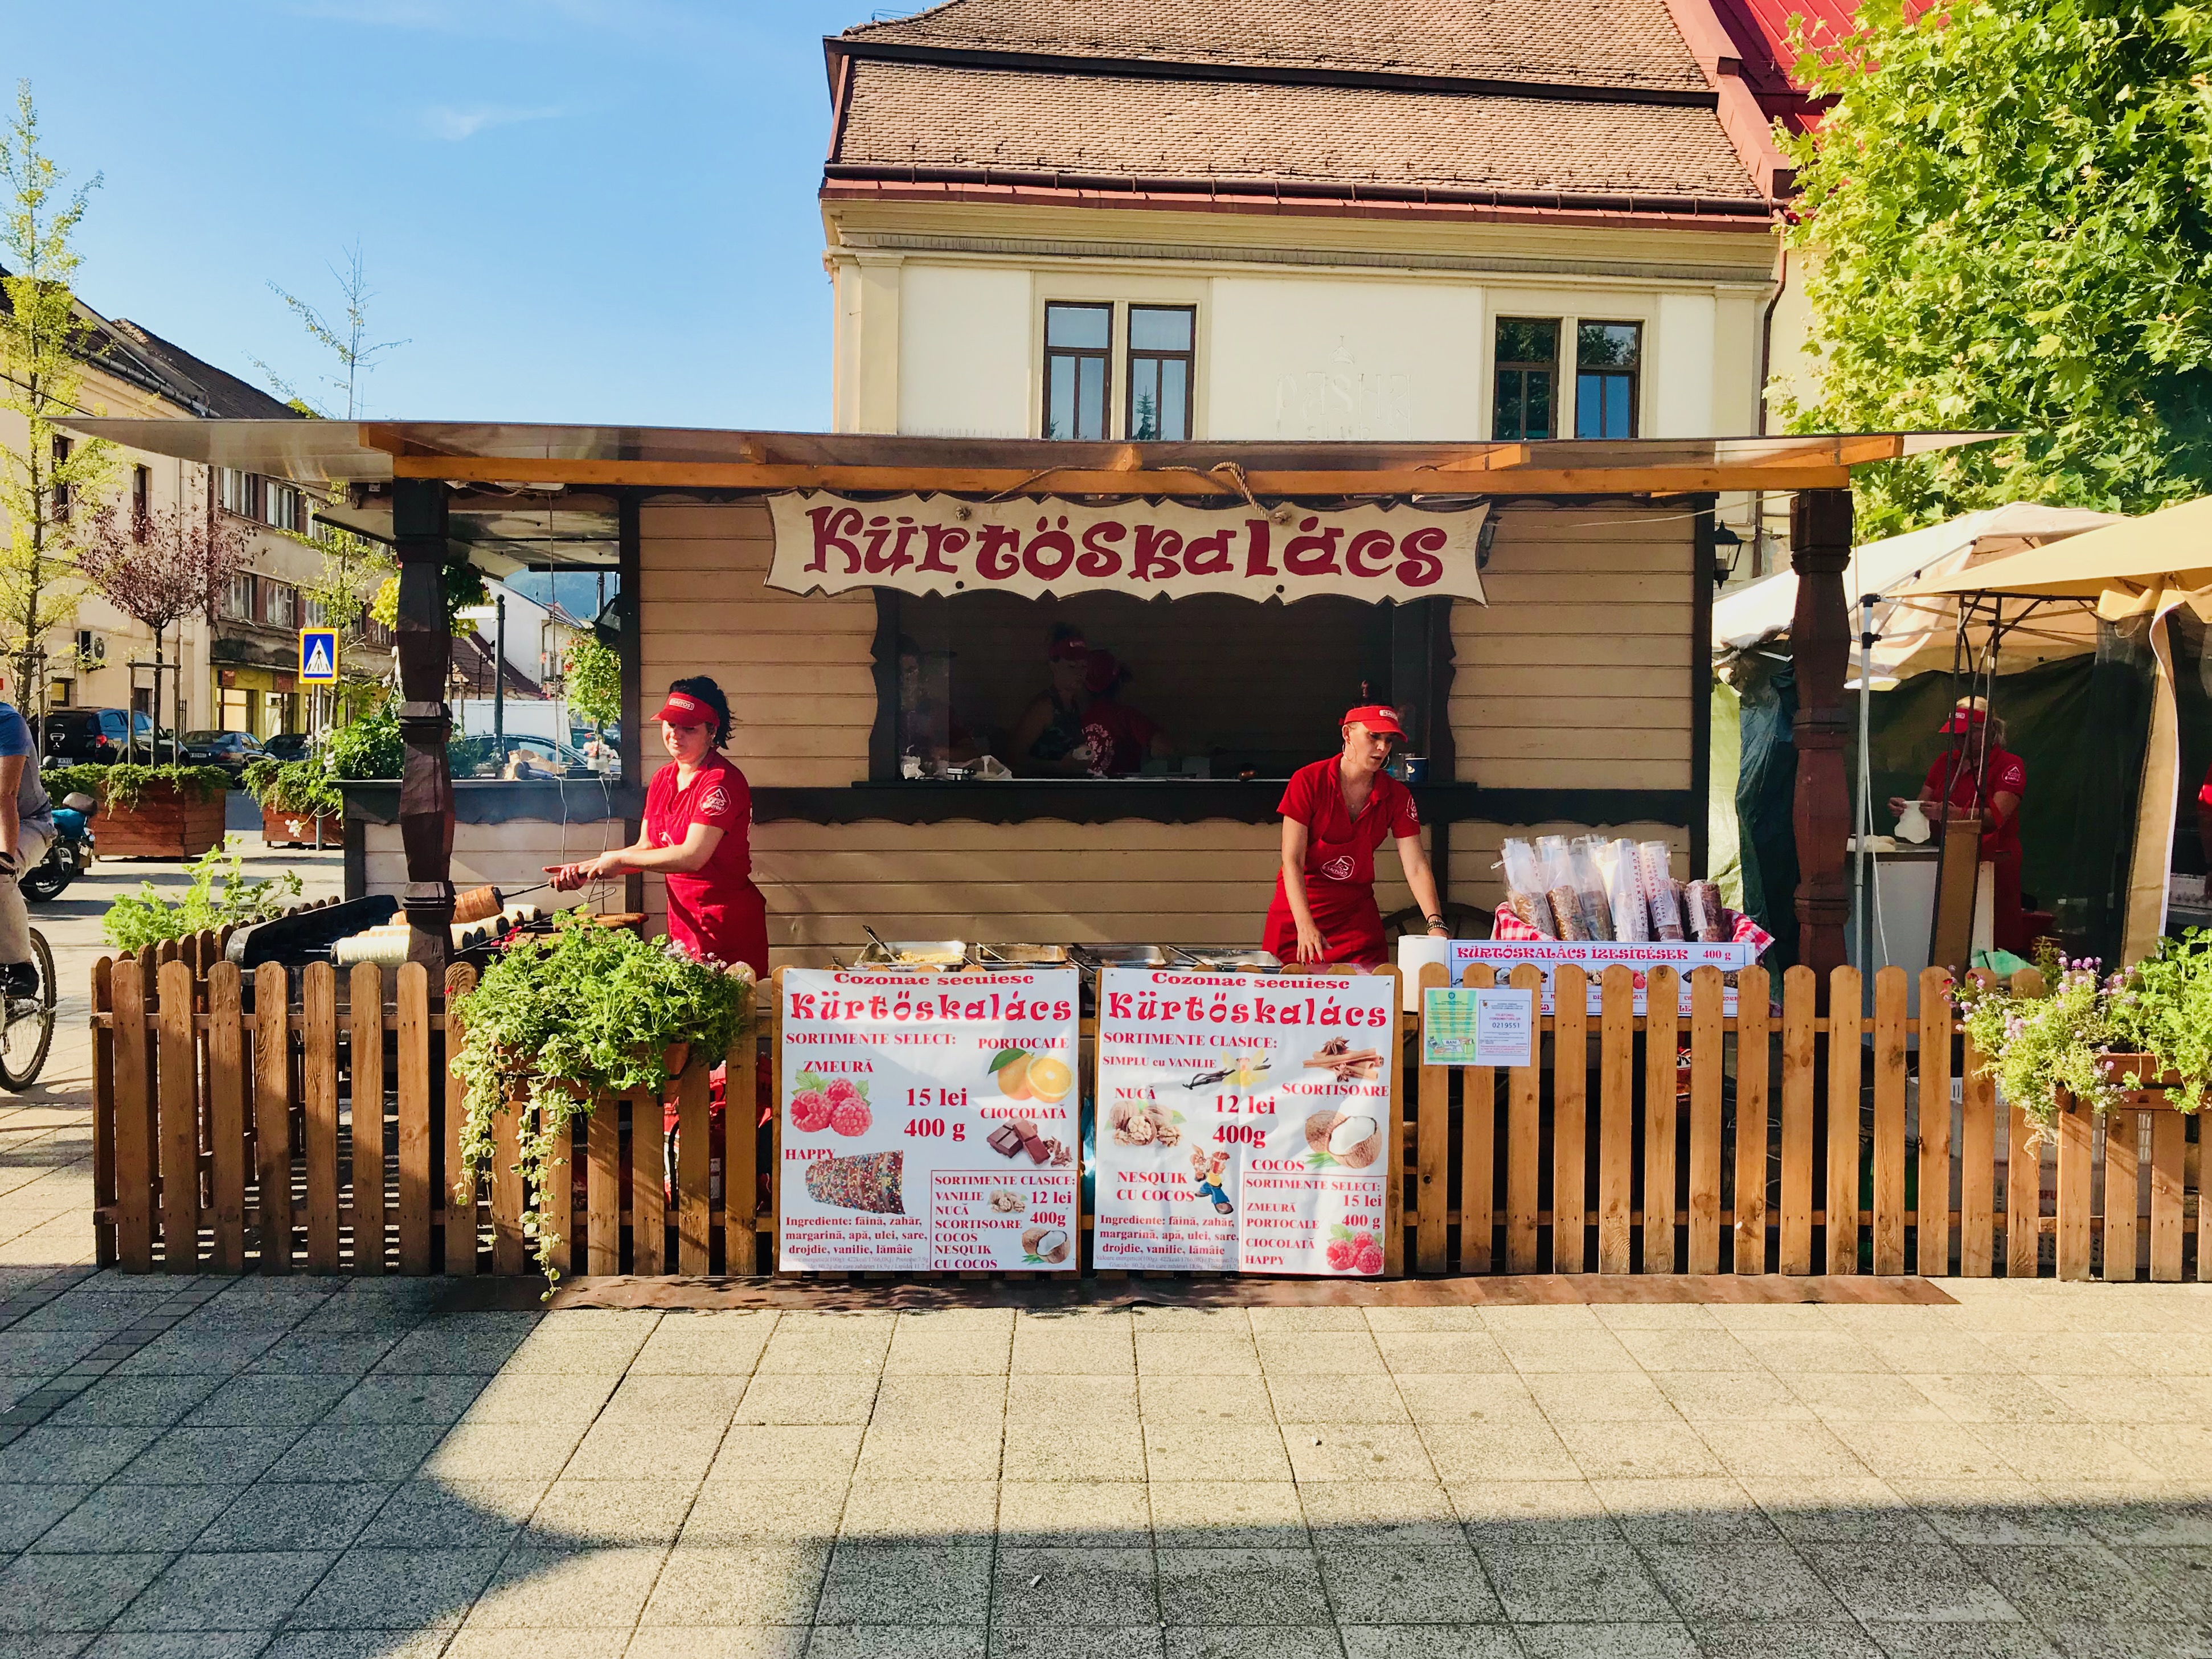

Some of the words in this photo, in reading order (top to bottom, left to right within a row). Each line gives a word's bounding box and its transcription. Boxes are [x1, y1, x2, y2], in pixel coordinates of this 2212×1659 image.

[1591, 945, 1688, 960] ÍZESÍTÉSEK
[1703, 950, 1722, 959] 400
[1724, 952, 1731, 961] g
[833, 972, 930, 986] Cozonac
[937, 973, 1035, 985] secuiesc
[1151, 972, 1247, 986] Cozonac
[1254, 977, 1350, 990] secuiesc
[790, 990, 1072, 1021] Kürtőskalács
[1108, 992, 1387, 1027] Kürtőskalács
[786, 1033, 889, 1044] SORTIMENTE
[894, 1033, 956, 1045] SELECT:
[978, 1038, 1069, 1049] PORTOCALE
[1103, 1032, 1205, 1046] SORTIMENTE
[1210, 1036, 1277, 1048] CLASICE:
[804, 1058, 874, 1073] ZMEURĂ
[1103, 1056, 1149, 1066] SIMPLU
[1169, 1059, 1216, 1068] VANILIE
[906, 1088, 931, 1107] 15
[940, 1087, 968, 1107] lei
[1115, 1086, 1156, 1099] NUCĂ
[1215, 1095, 1239, 1113] 12
[1247, 1096, 1276, 1114] lei
[980, 1104, 1067, 1119] CIOCOLATĂ
[904, 1119, 945, 1137] 400
[952, 1123, 965, 1141] g
[1212, 1125, 1267, 1148] 400g
[785, 1149, 835, 1160] HAPPY
[1252, 1160, 1305, 1171] COCOS
[935, 1176, 1017, 1185] SORTIMENTE
[1021, 1176, 1075, 1185] CLASICE:
[1117, 1171, 1187, 1185] NESQUIK
[1246, 1179, 1327, 1190] SORTIMENTE
[1332, 1182, 1381, 1191] SELECT:
[935, 1191, 984, 1201] VANILIE
[1031, 1191, 1048, 1204] 12
[1053, 1191, 1072, 1204] lei
[1117, 1190, 1138, 1201] CU
[1142, 1190, 1195, 1202] COCOS
[1343, 1195, 1360, 1207] 15
[1365, 1194, 1382, 1207] lei
[935, 1203, 969, 1215] NUCĂ
[1247, 1202, 1296, 1212] ZMEURĂ
[786, 1216, 852, 1228] Ingrediente:
[855, 1216, 886, 1227] făină,
[889, 1217, 922, 1227] zahăr,
[1030, 1211, 1066, 1227] 400g
[1100, 1215, 1165, 1227] Ingrediente:
[1168, 1215, 1199, 1227] făină,
[1202, 1216, 1235, 1228] zahăr,
[1246, 1218, 1319, 1229] PORTOCALE
[1342, 1215, 1368, 1226] 400
[1373, 1218, 1381, 1229] g
[849, 1231, 871, 1243] apă,
[875, 1230, 898, 1242] ulei,
[902, 1232, 927, 1242] sare,
[935, 1232, 978, 1242] COCOS
[1162, 1230, 1184, 1242] apă,
[1188, 1230, 1211, 1242] ulei,
[1215, 1232, 1239, 1243] sare,
[1246, 1237, 1315, 1249] CIOCOLATĂ
[788, 1245, 830, 1256] drojdie,
[833, 1245, 872, 1256] vanilie,
[935, 1245, 992, 1256] NESQUIK
[1102, 1243, 1144, 1256] drojdie,
[1146, 1244, 1186, 1256] vanilie,
[935, 1259, 952, 1268] CU
[955, 1259, 997, 1268] COCOS
[1245, 1255, 1285, 1265] HAPPY
